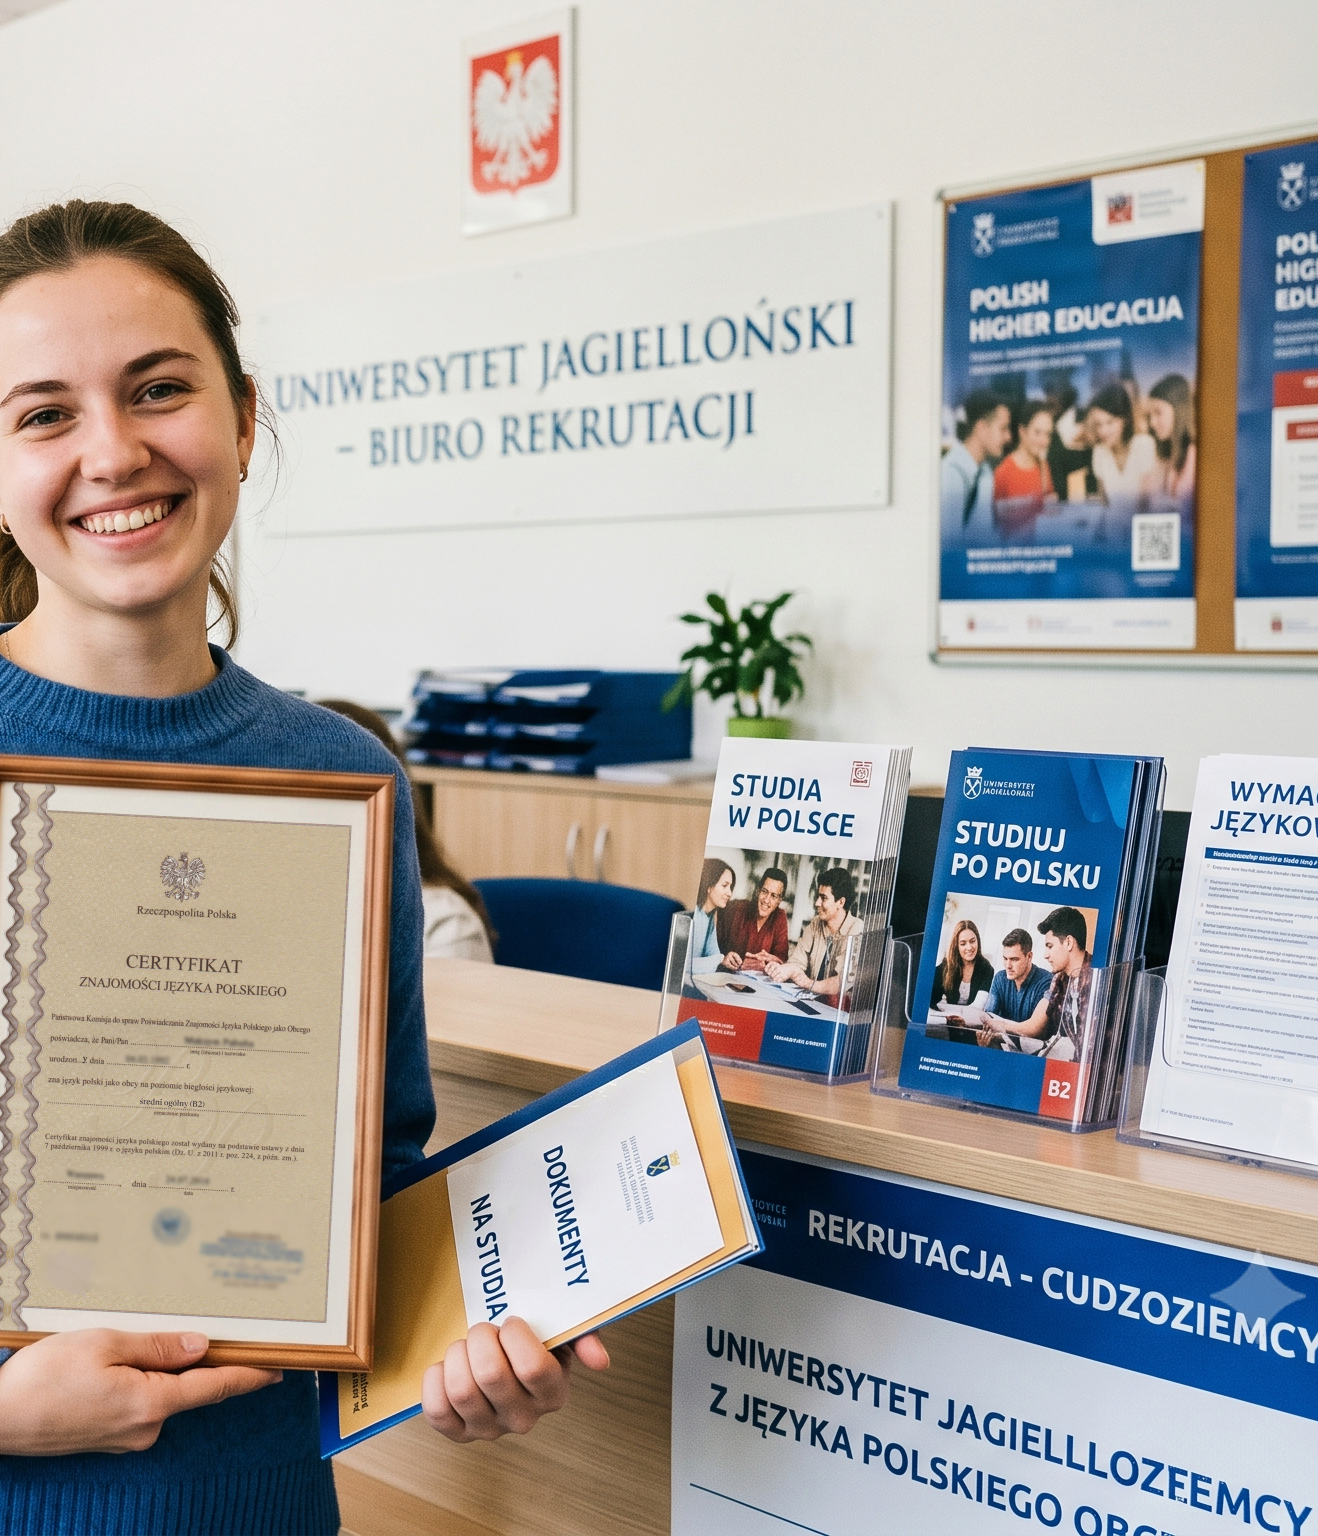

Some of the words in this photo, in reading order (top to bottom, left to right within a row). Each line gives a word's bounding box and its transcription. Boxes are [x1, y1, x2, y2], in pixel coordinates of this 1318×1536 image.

[969, 279, 1050, 313] POLISH
[969, 311, 1051, 343] HIGHER
[274, 343, 526, 414] UNIWERSYTET
[538, 296, 855, 395] JAGIELLOŃSKI
[369, 418, 484, 467] BIURO
[500, 389, 755, 457] REKRUTACJI
[731, 773, 822, 802] STUDIA
[1230, 781, 1318, 806] WYMA
[728, 804, 751, 828] W
[757, 807, 855, 838] POLSCE
[1210, 810, 1318, 838] JĘZYKO
[954, 820, 1067, 853] STUDIUJ
[951, 853, 988, 879] PO
[994, 856, 1101, 890] POLSKU
[136, 905, 205, 918] Rzeczpospolita
[207, 909, 237, 920] Polska
[125, 954, 243, 974] CERTYFIKAT
[79, 976, 160, 991] ZNAJOMOŚCI
[163, 981, 213, 994] JĘZYKA
[216, 983, 287, 998] POLSKIEGO
[51, 1013, 85, 1022] Państwowa
[86, 1015, 112, 1024] Komisja
[112, 1016, 120, 1024] do
[121, 1018, 139, 1026] spraw
[140, 1017, 185, 1027] Poświadczania
[185, 1020, 220, 1029] Znajomości
[221, 1021, 242, 1031] Języka
[243, 1023, 272, 1032] Polskiego
[273, 1024, 286, 1033] jako
[287, 1025, 311, 1034] Obcego
[50, 1035, 90, 1044] poświadcza,
[91, 1036, 100, 1044] że
[100, 1036, 129, 1045] Pani/Pan
[89, 1057, 105, 1065] dnia
[61, 1077, 81, 1086] język
[82, 1078, 104, 1086] polski
[104, 1078, 120, 1087] jako
[121, 1080, 138, 1088] obcy
[150, 1081, 182, 1090] poziomie
[183, 1082, 215, 1092] biegłości
[1047, 1079, 1072, 1099] B2
[139, 1098, 163, 1106] średni
[163, 1099, 188, 1109] ogólny
[189, 1100, 206, 1108] (B2)
[45, 1133, 77, 1142] Certyfikat
[78, 1135, 115, 1144] znajomości
[115, 1136, 137, 1145] języka
[138, 1138, 170, 1147] polskiego
[192, 1141, 217, 1150] wydany
[227, 1143, 260, 1151] podstawie
[261, 1145, 283, 1153] ustawy
[290, 1145, 305, 1153] dnia
[50, 1143, 91, 1151] października
[93, 1144, 109, 1152] 1999
[121, 1146, 143, 1155] języku
[144, 1148, 170, 1156] polskim
[171, 1148, 186, 1157] (Dz.
[187, 1149, 196, 1157] U.
[202, 1150, 218, 1158] 2011
[225, 1152, 240, 1160] poz.
[241, 1152, 256, 1160] 224,
[262, 1154, 280, 1162] późn.
[131, 1180, 147, 1188] dnia
[470, 1193, 495, 1232] NA
[543, 1144, 589, 1287] DOKUMENTY
[476, 1232, 508, 1321] STUDIA
[808, 1209, 1012, 1288] REKRUTACJA
[1042, 1266, 1318, 1364] CUDZOZIEMCY
[705, 1325, 930, 1420] UNIWERSYTET
[709, 1384, 729, 1418] Z
[735, 1393, 853, 1460] JĘZYKA
[863, 1434, 1062, 1528] POLSKIEGO
